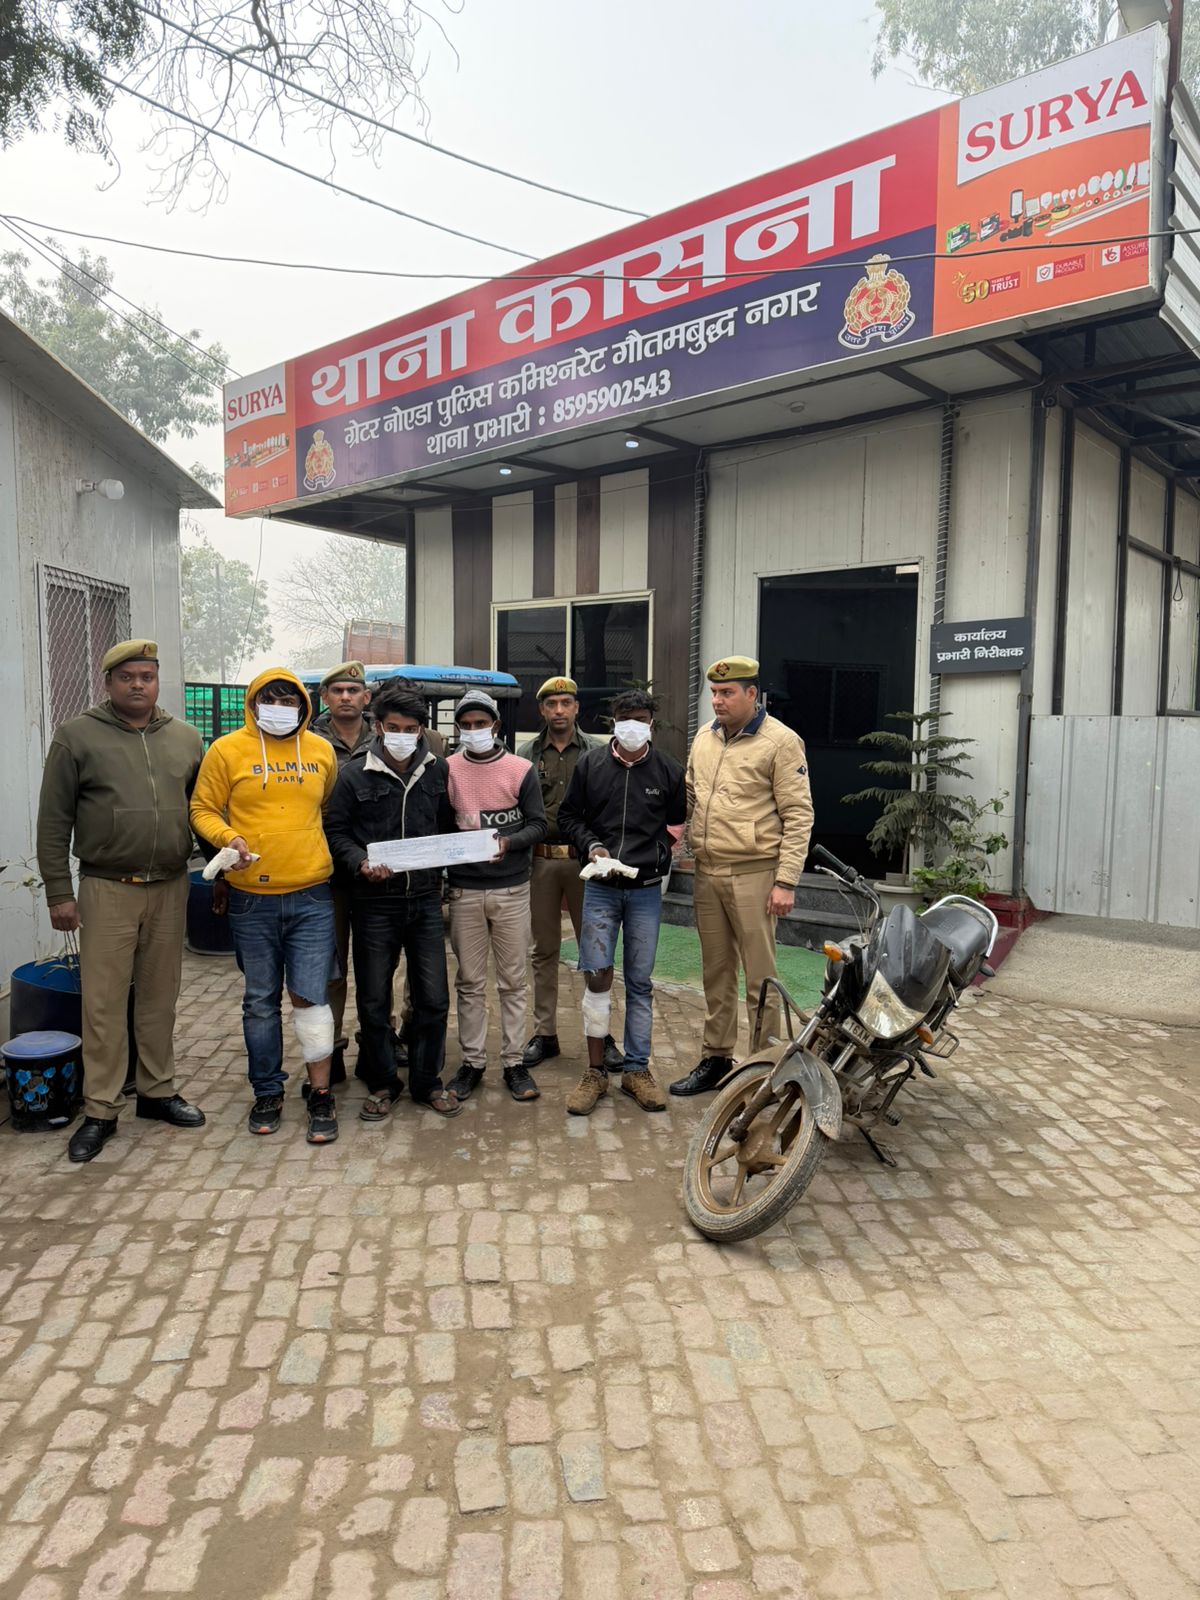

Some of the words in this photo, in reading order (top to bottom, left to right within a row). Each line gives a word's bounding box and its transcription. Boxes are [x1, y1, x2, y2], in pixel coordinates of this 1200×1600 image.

[965, 70, 1148, 163] SURYA
[1122, 242, 1148, 253] ASSURE
[311, 310, 475, 407] थाना
[496, 154, 896, 343] कासना
[962, 279, 989, 304] 50
[991, 278, 1019, 293] TRUST
[344, 417, 380, 448] ग्रेटर
[383, 402, 433, 433] नोएडा
[437, 385, 494, 427] पुलिस
[498, 347, 608, 400] कमिश्नरेट
[612, 306, 738, 365] गौतमबुद्ध
[745, 282, 821, 325] नगर
[227, 383, 284, 421] SURYA
[427, 426, 469, 454] थाना
[474, 401, 532, 447] प्रभारी
[552, 369, 671, 424] 8595902543
[954, 628, 1007, 642] कार्यालय
[936, 647, 971, 663] प्रभारी
[974, 645, 1025, 660] निरीक्षक
[253, 762, 319, 774] BALMAIN
